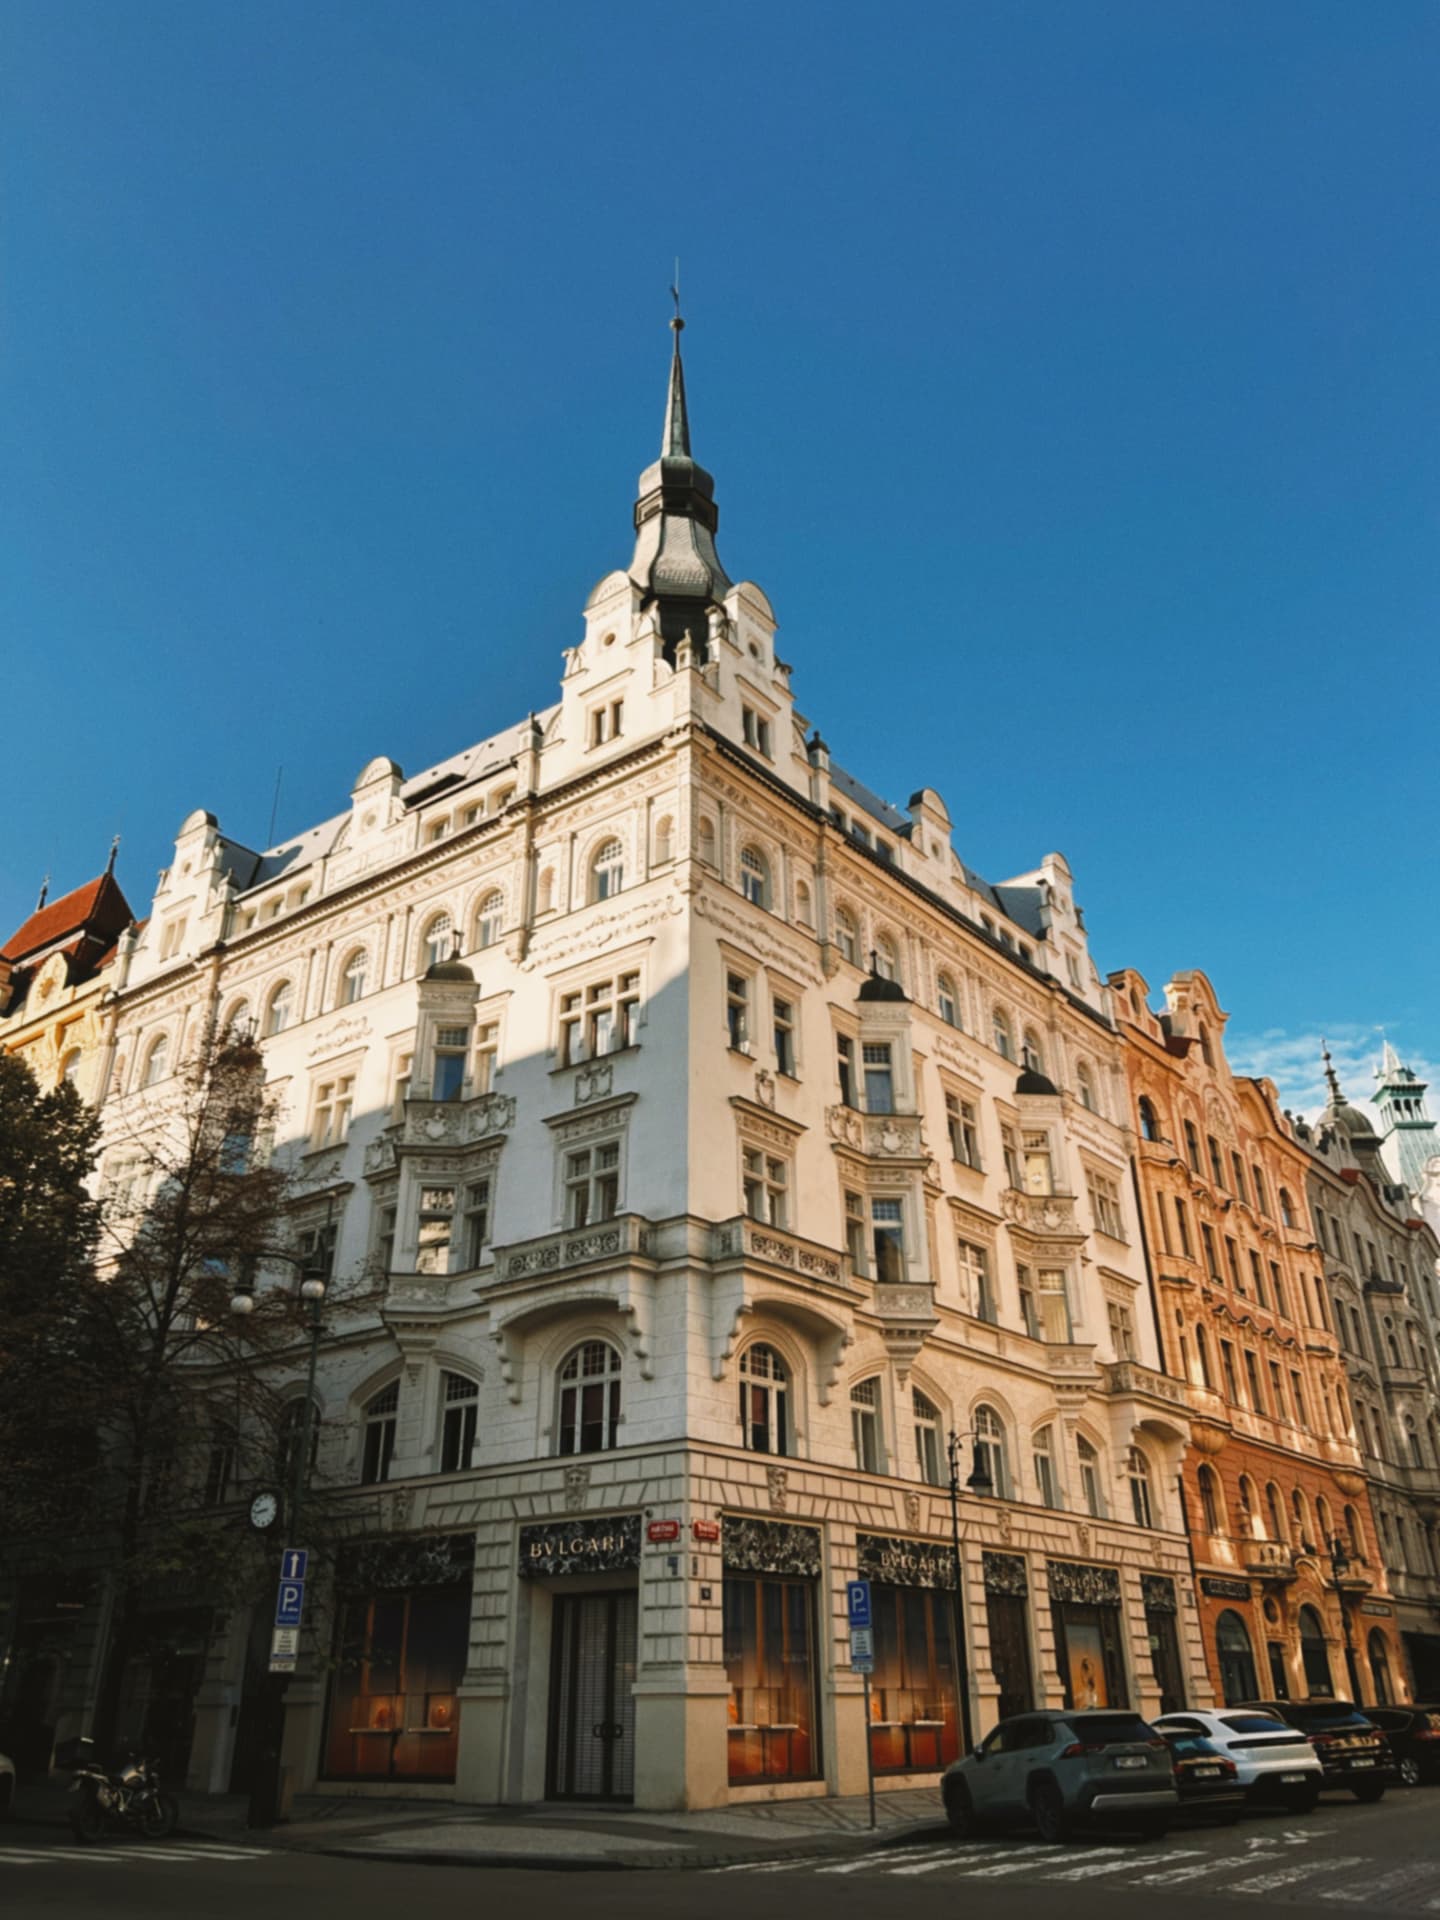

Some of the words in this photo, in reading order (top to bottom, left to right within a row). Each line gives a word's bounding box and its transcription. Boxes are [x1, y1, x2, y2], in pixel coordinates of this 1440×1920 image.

[530, 1536, 624, 1558] BVLGARI
[283, 1587, 298, 1612] P
[852, 1587, 864, 1613] P
